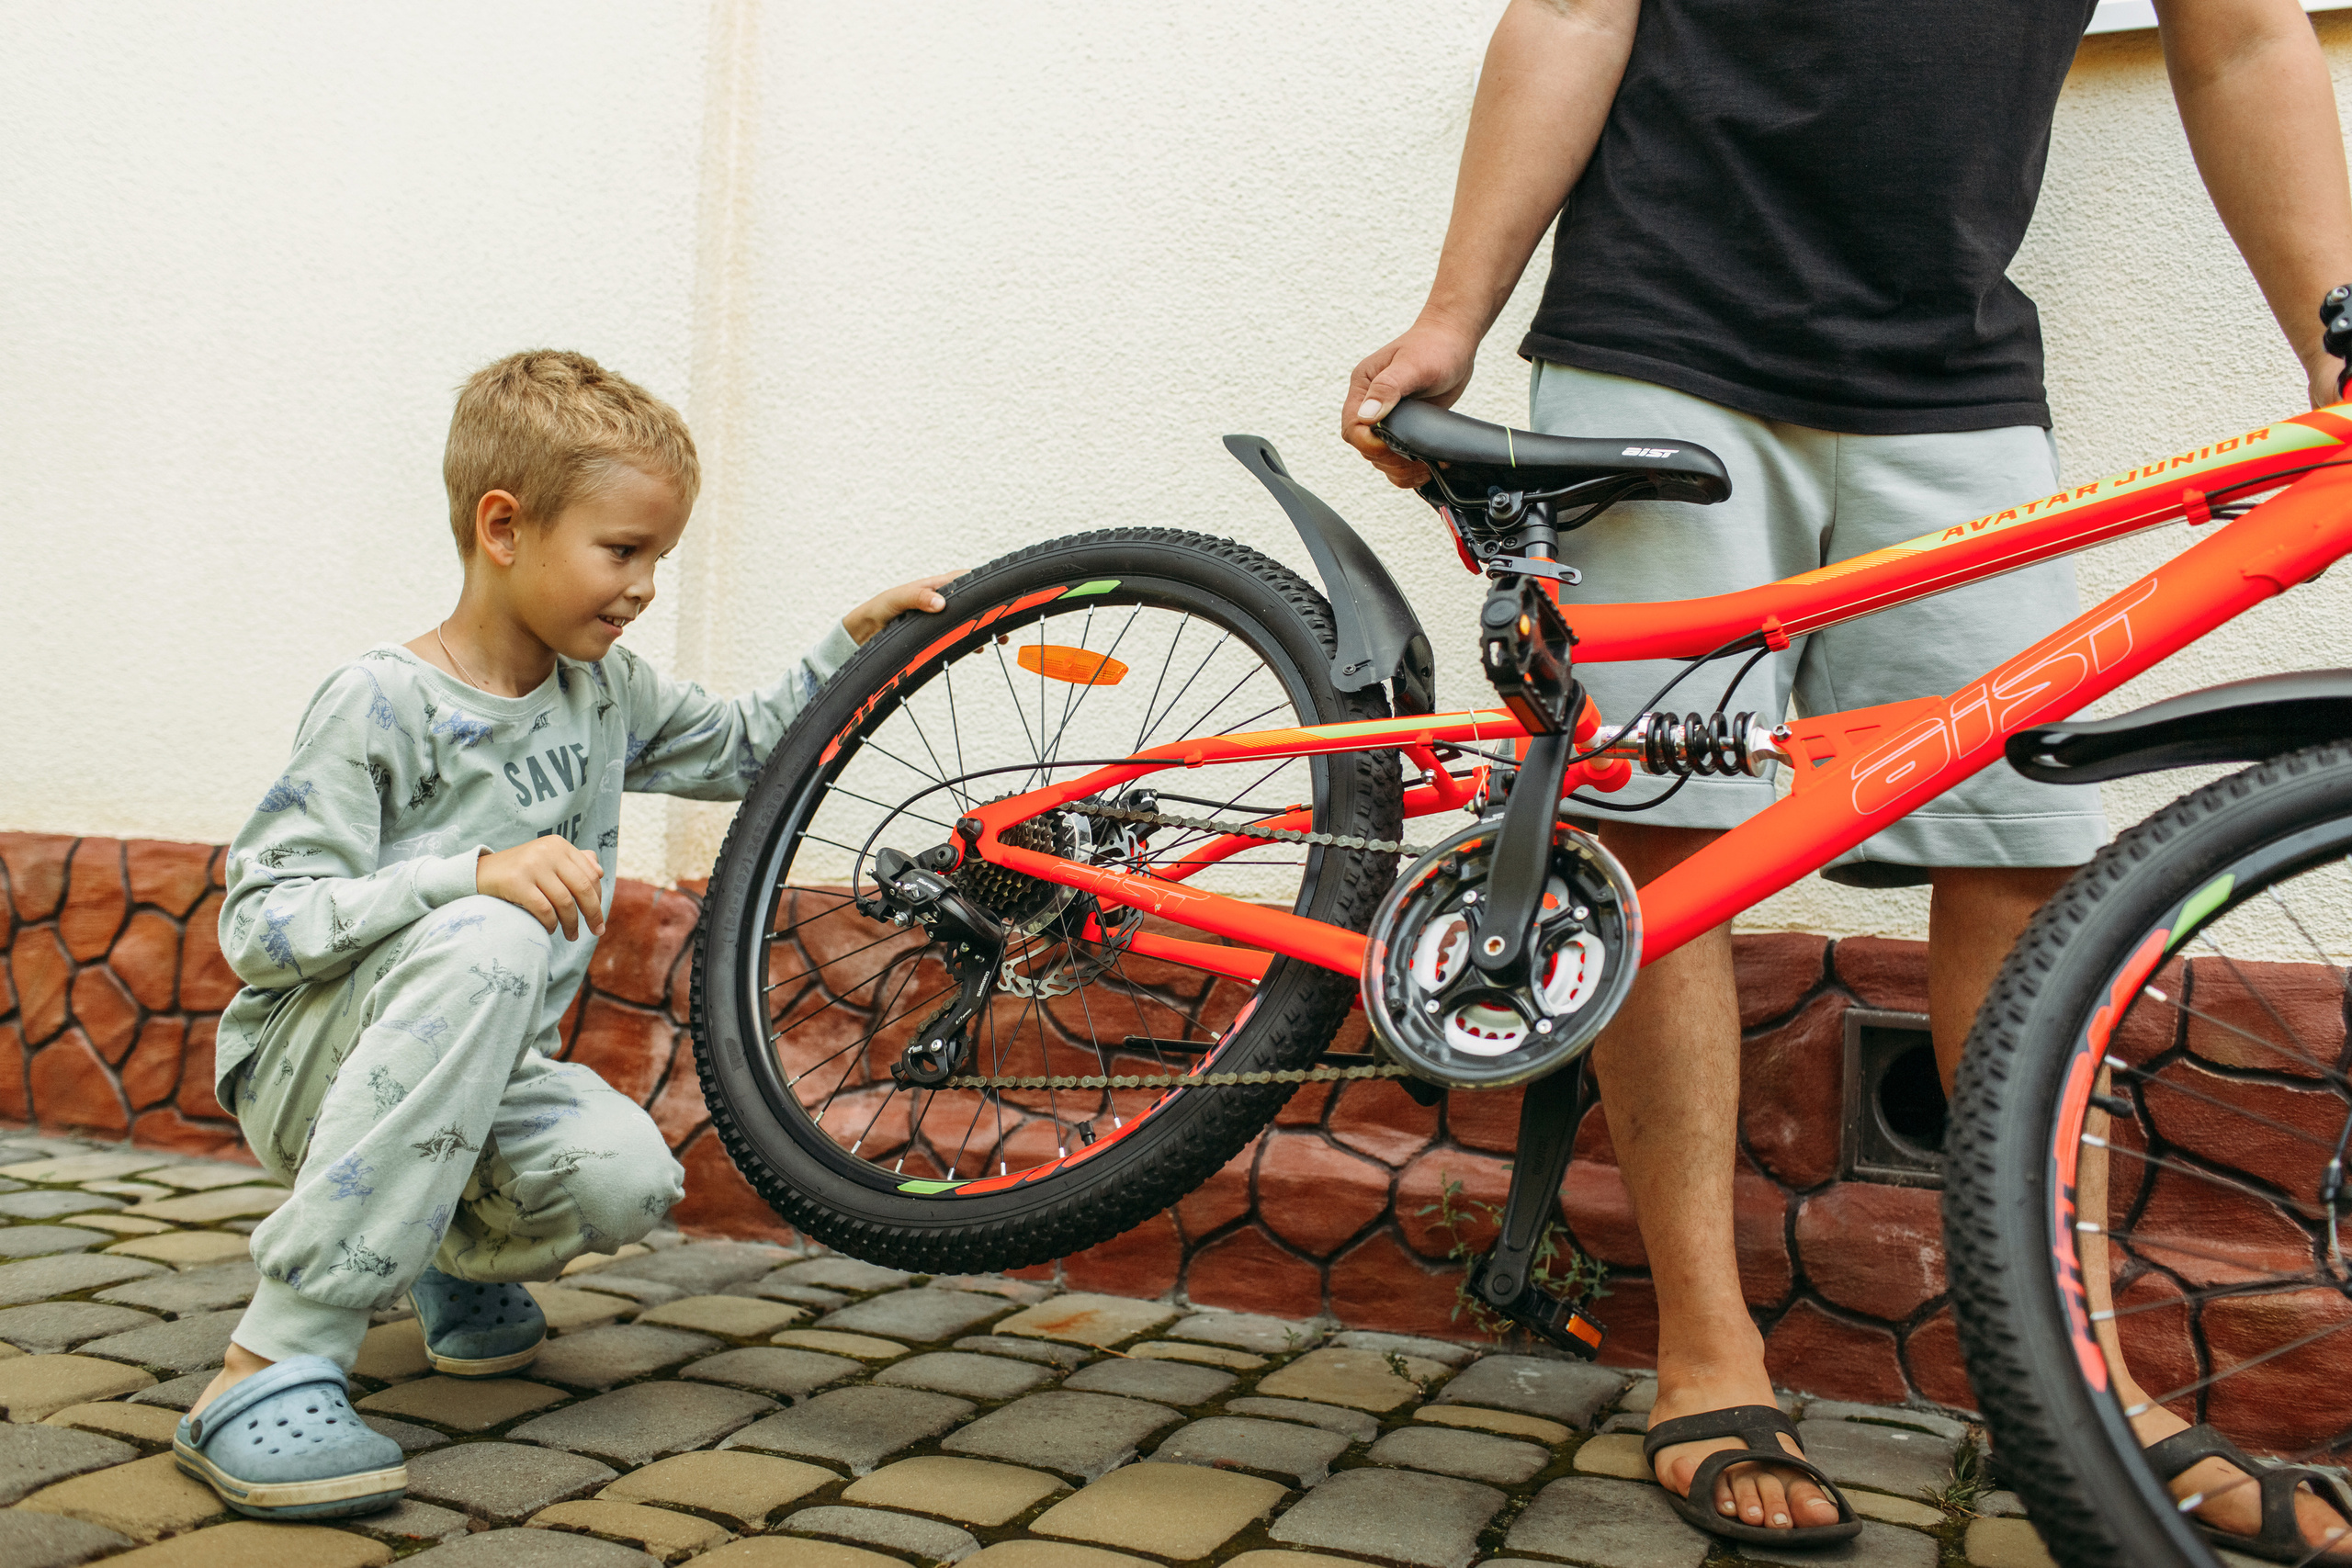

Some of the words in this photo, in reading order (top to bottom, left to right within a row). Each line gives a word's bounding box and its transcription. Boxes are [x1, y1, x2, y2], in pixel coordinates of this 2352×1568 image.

[1941, 481, 2100, 542] AVATAR
[2113, 428, 2271, 488] JUNIOR
[503, 742, 589, 808] SAVE
